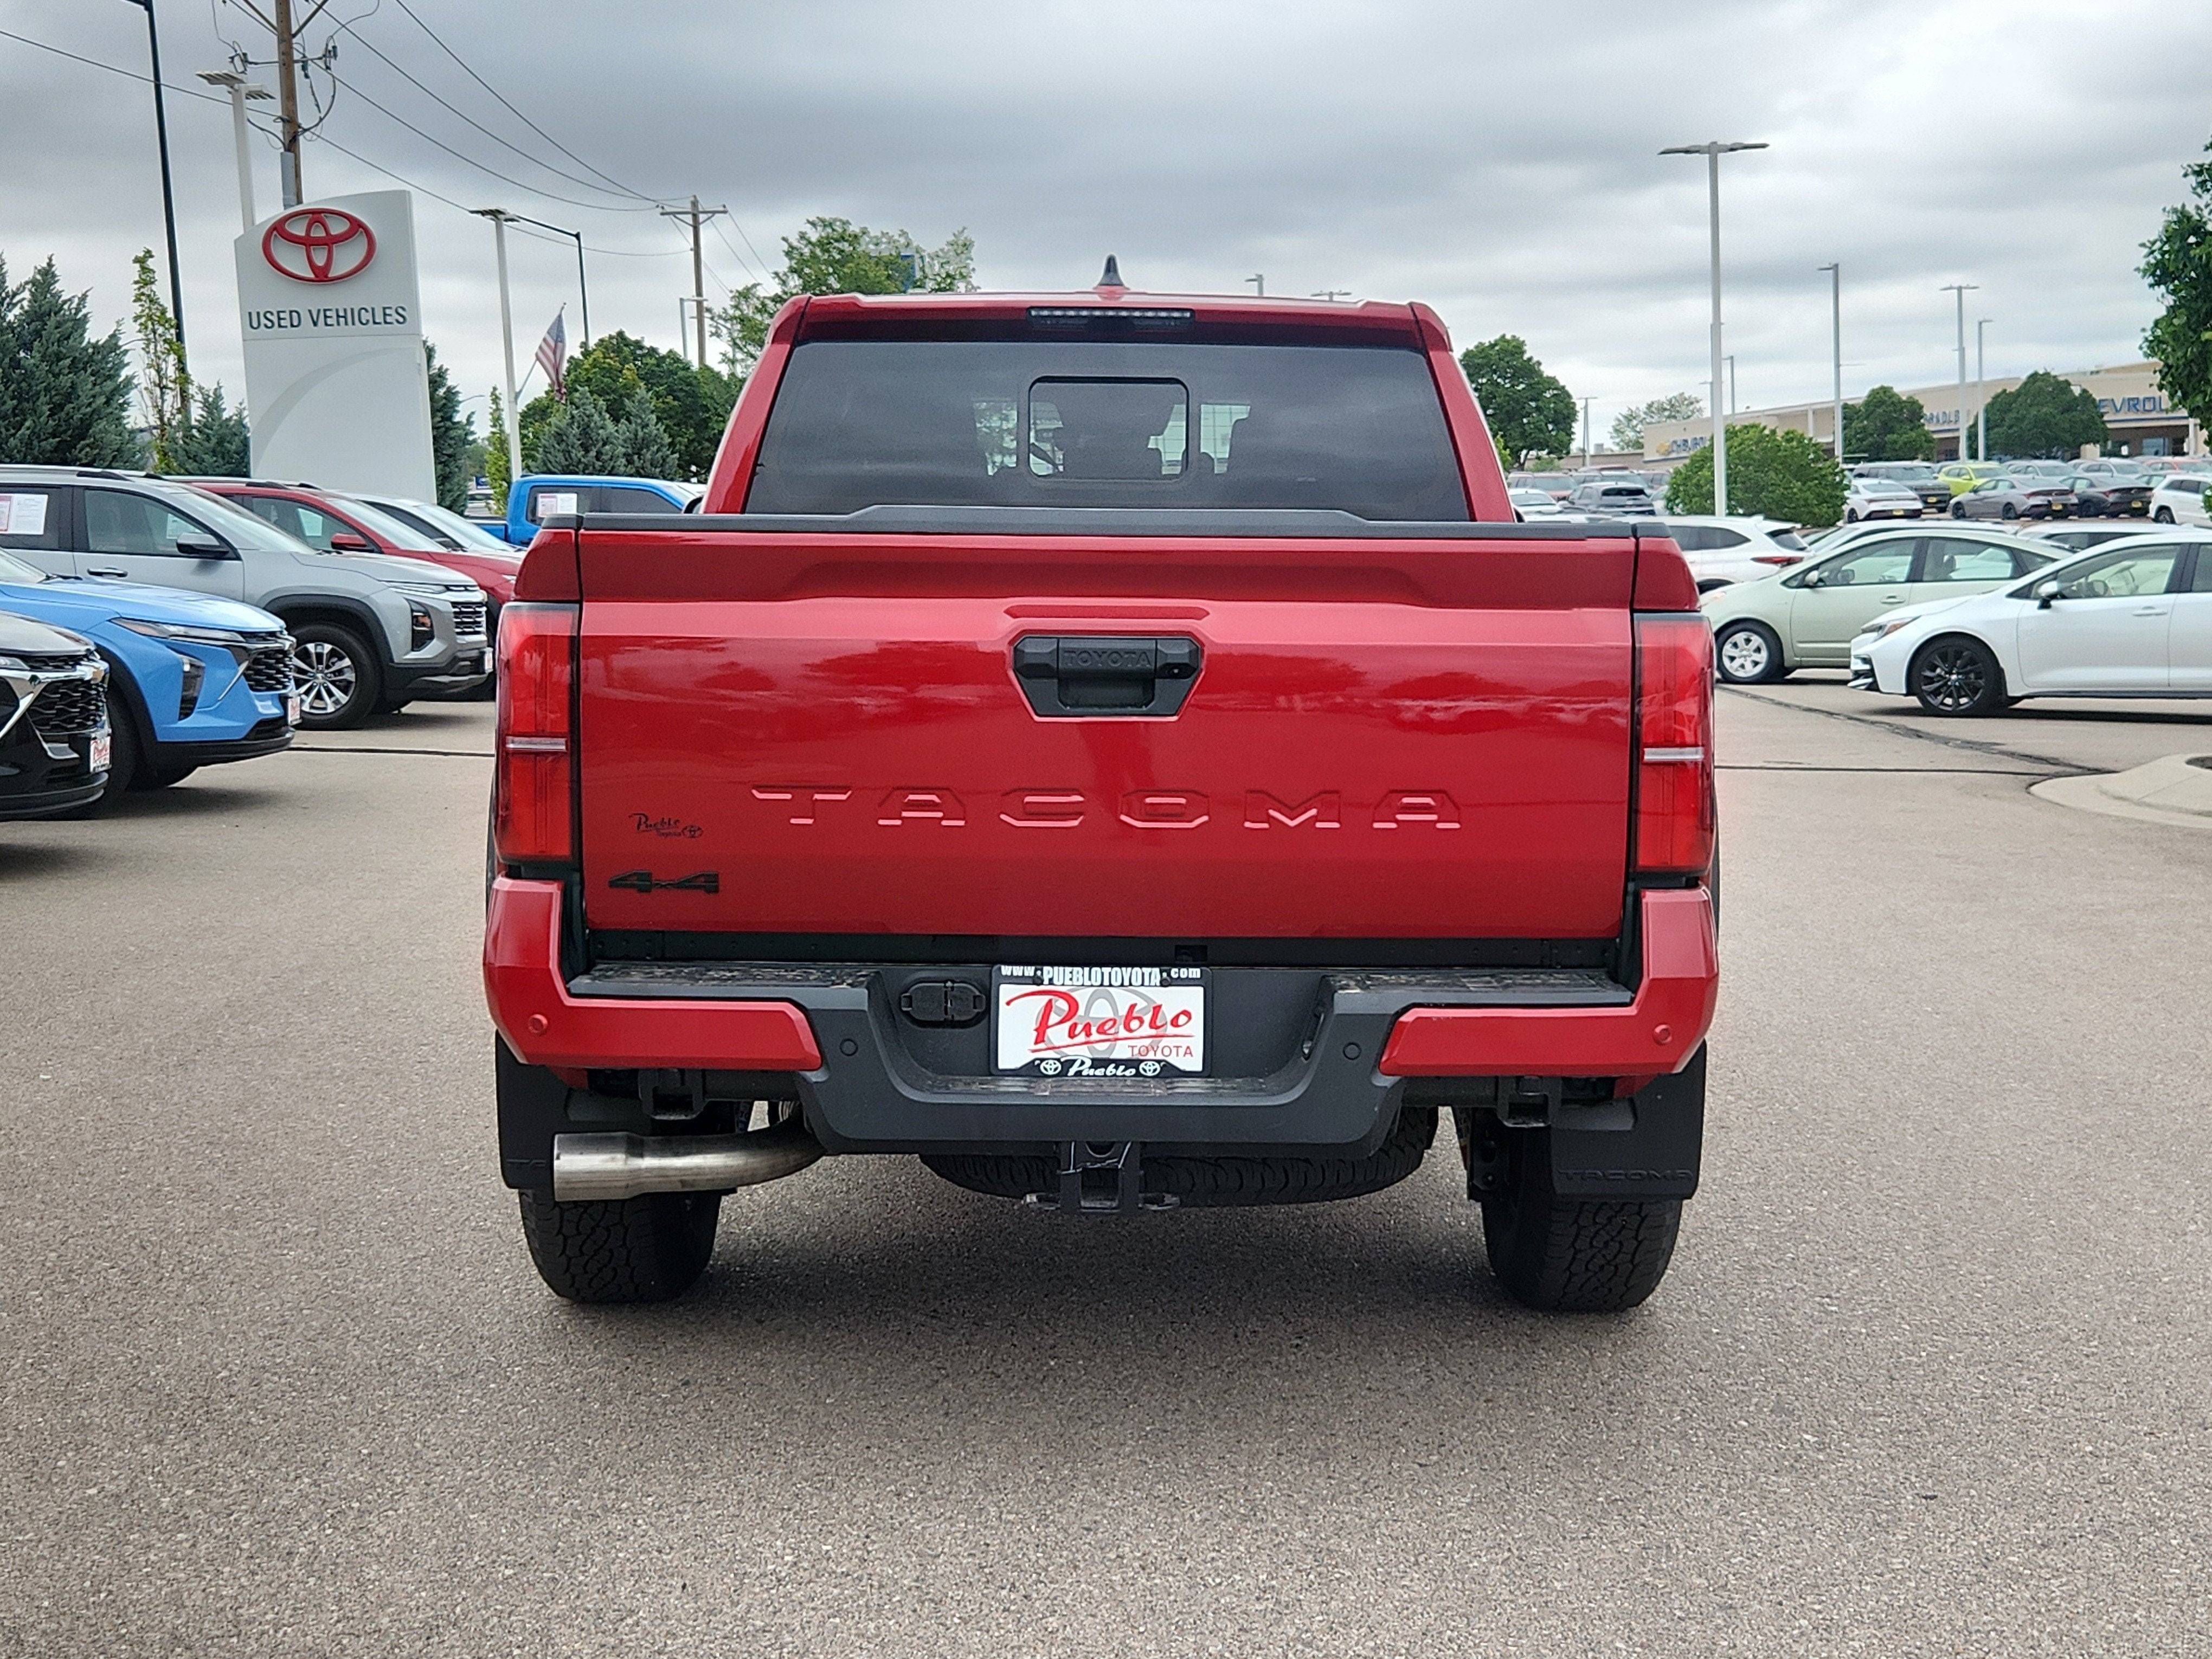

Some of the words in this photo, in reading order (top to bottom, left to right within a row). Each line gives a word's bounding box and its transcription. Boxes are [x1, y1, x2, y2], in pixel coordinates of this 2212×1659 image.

[248, 309, 301, 330] USED
[308, 305, 408, 327] VEHICLES
[1064, 651, 1153, 667] TOYOTA
[751, 785, 1461, 829] TACOMA
[1005, 989, 1192, 1045] Pueblo
[1128, 1045, 1194, 1057] TOYOTA
[1060, 1055, 1136, 1077] Pueblo
[1558, 1169, 1694, 1180] TACOMA
